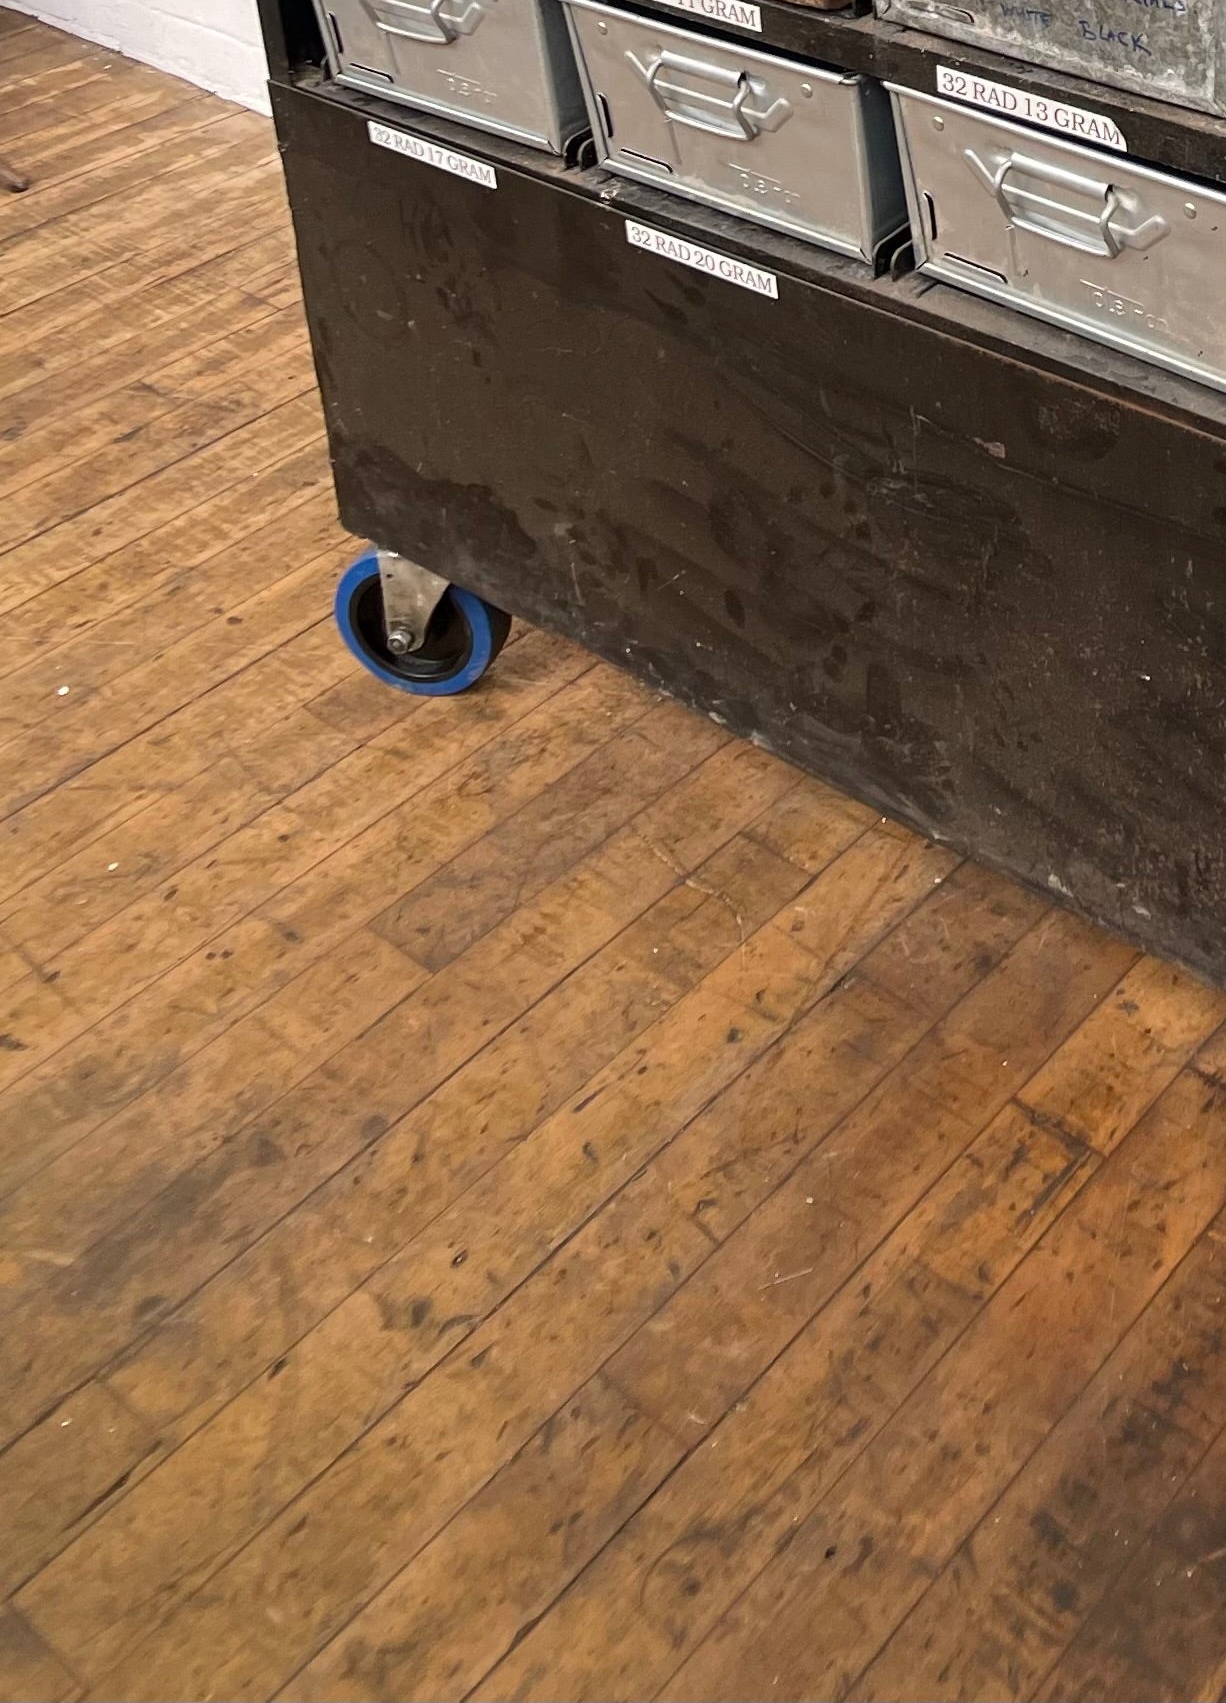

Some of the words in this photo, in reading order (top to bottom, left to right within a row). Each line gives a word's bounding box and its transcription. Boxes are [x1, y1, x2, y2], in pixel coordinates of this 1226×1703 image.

[1079, 20, 1151, 55] BLACK
[942, 72, 968, 96] 32
[972, 81, 1017, 111] RAD
[1025, 98, 1048, 122] 13
[1054, 108, 1121, 145] GRAM
[373, 126, 391, 145] 32
[393, 134, 425, 157] RAD
[427, 147, 444, 164] 17
[447, 155, 492, 184] GRAM
[631, 226, 652, 247] 32
[655, 234, 691, 261] RAD
[694, 250, 716, 271] 20
[719, 260, 772, 293] GRAM
